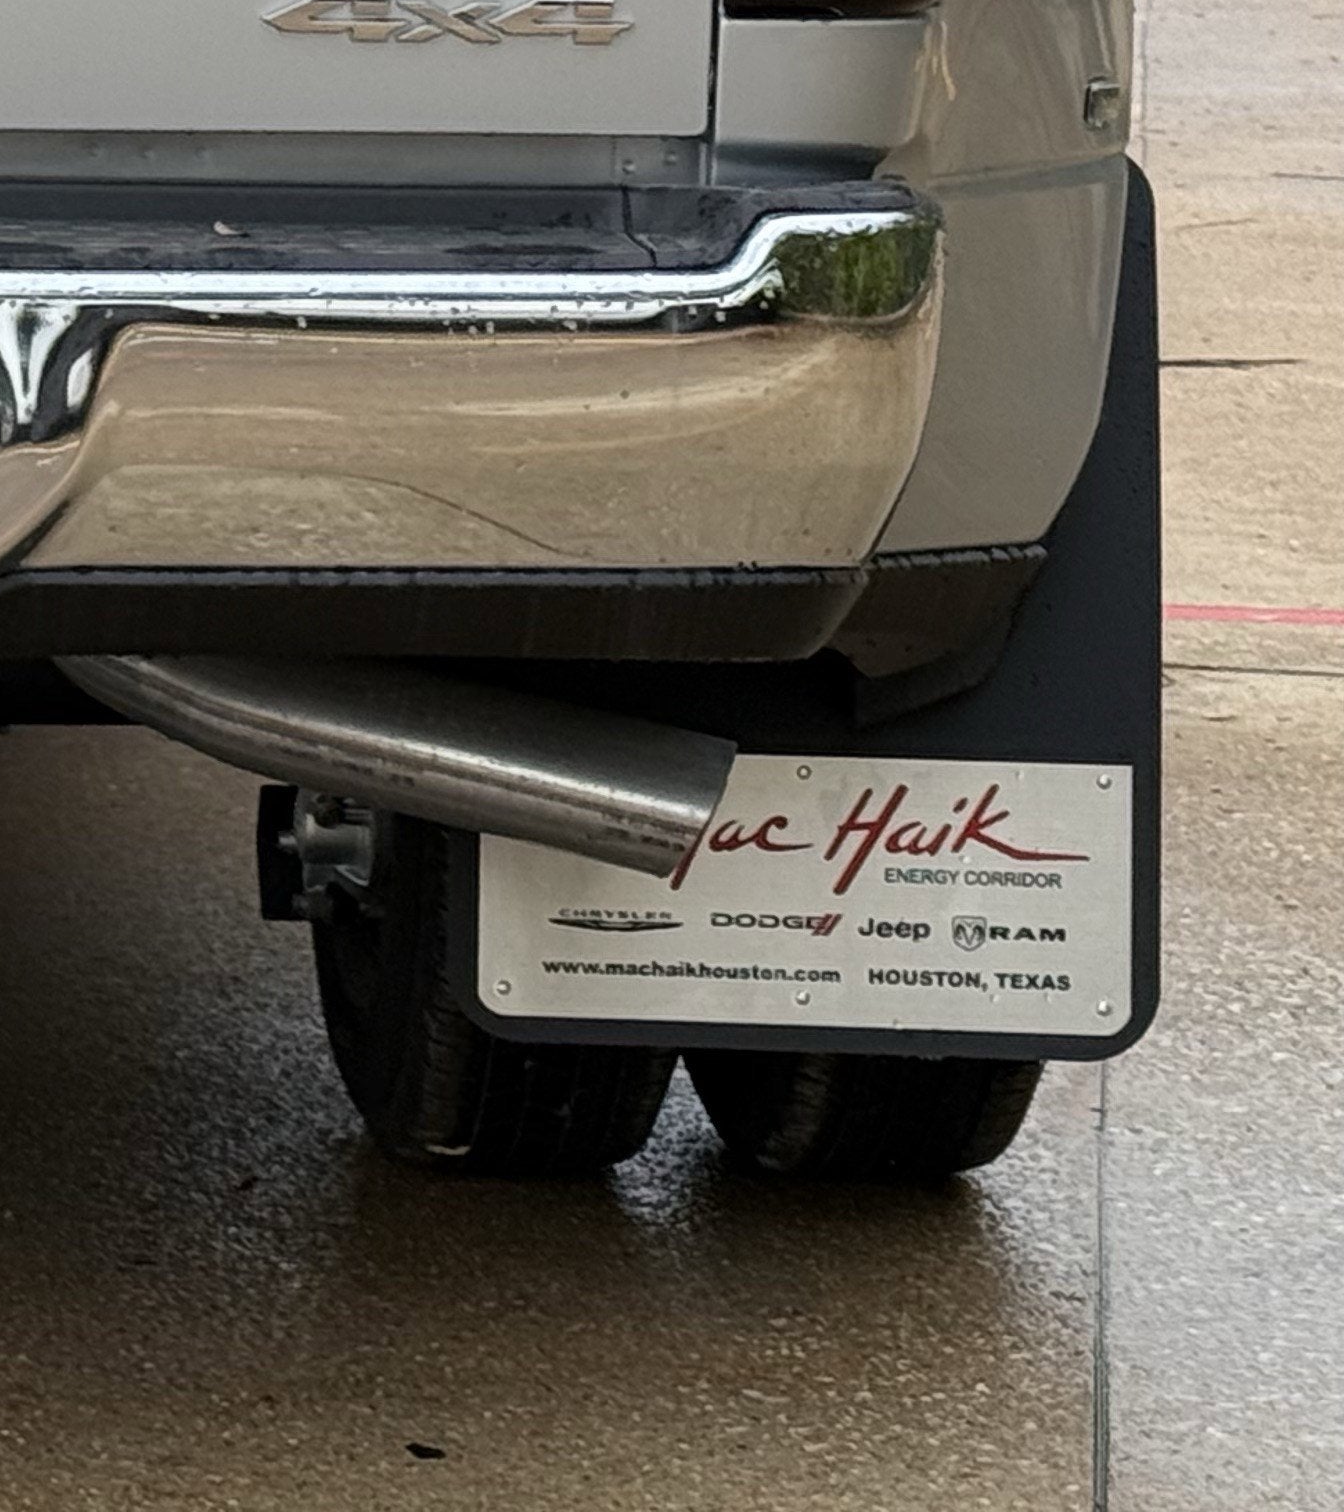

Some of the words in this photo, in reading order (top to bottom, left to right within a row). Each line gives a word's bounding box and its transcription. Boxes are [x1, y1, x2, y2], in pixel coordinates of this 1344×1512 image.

[824, 785, 1090, 895] Haik
[884, 868, 960, 886] ENERGY
[964, 871, 1063, 889] CORRIDOR
[710, 912, 822, 932] DODGE
[858, 917, 931, 942] Jeep
[990, 926, 1067, 942] RAM
[542, 960, 841, 983] www.machaikhouston.com
[868, 969, 988, 993] HOUSTON,
[994, 973, 1071, 991] TEXAS
